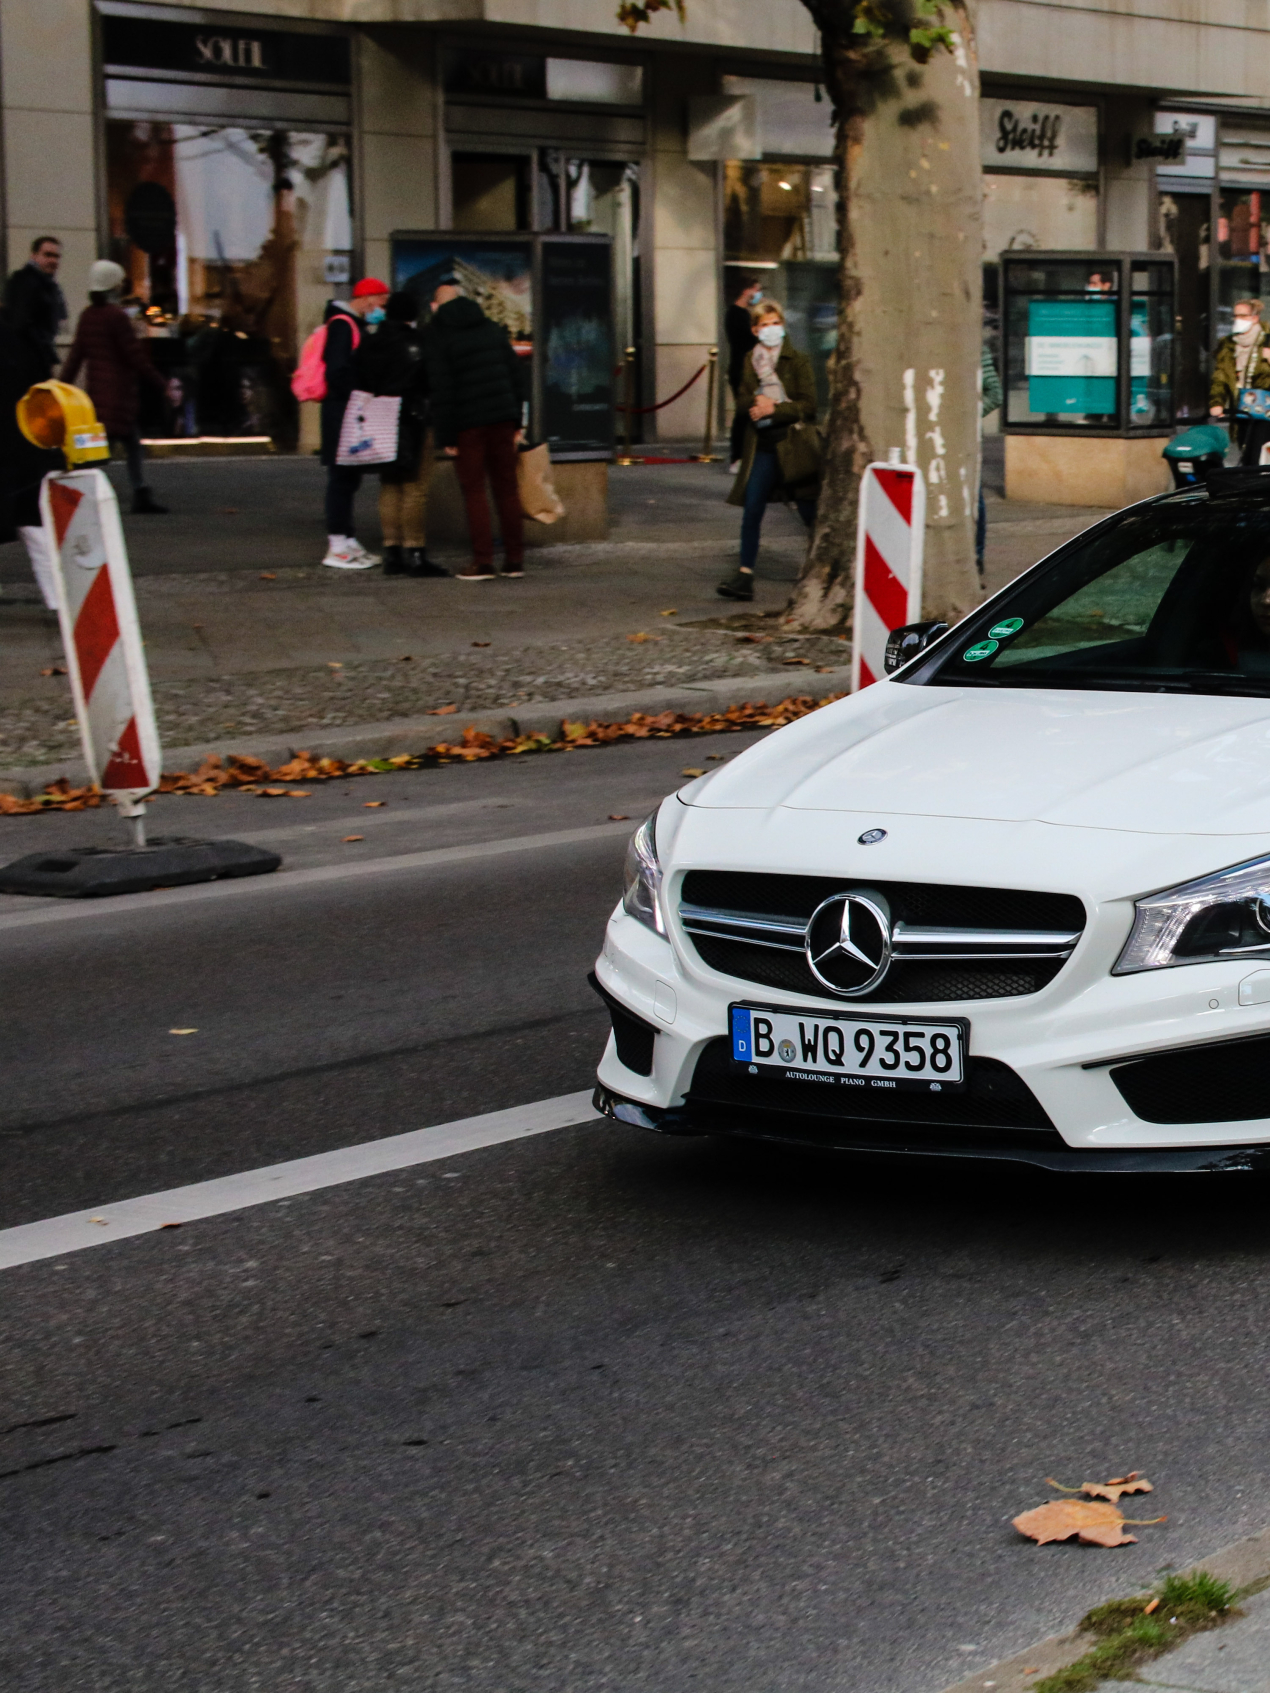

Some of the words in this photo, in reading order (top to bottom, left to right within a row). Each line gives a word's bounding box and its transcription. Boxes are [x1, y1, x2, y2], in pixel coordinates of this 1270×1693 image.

[195, 36, 267, 69] SOLEIL
[996, 109, 1061, 157] Steiff
[738, 1040, 747, 1052] D
[753, 1017, 775, 1058] B
[799, 1021, 845, 1067] WQ
[854, 1028, 953, 1074] 9358
[785, 1071, 835, 1083] AUTOLOUNGE
[840, 1077, 865, 1087] PIANO
